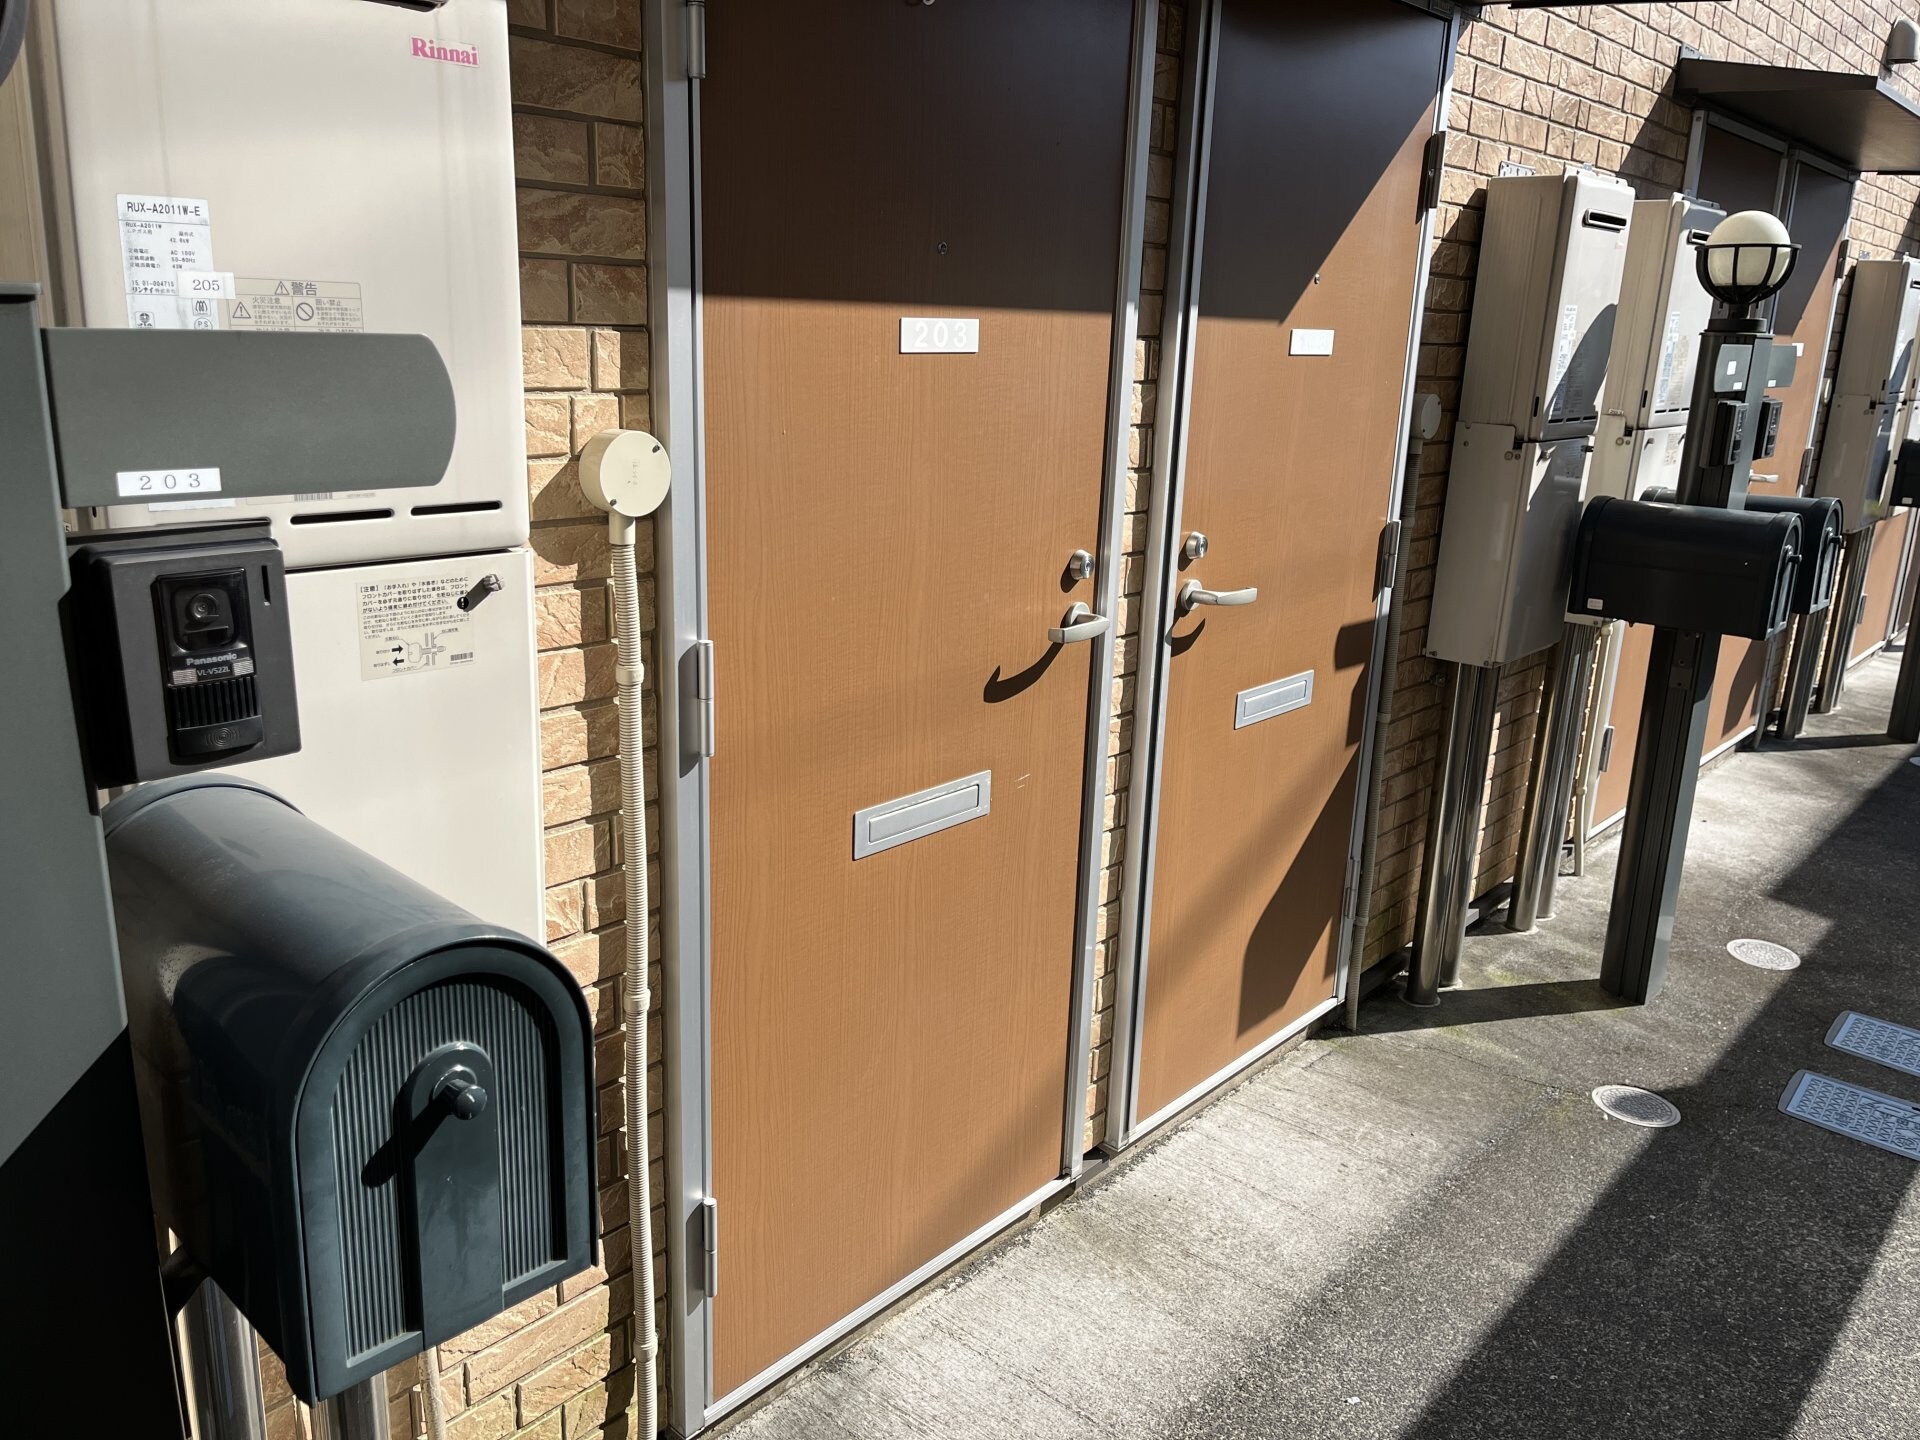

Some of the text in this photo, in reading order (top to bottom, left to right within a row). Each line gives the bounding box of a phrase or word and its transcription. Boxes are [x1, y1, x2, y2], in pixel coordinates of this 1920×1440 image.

[411, 37, 479, 65] Rinnai
[126, 201, 201, 217] RUX-A2011W-E
[192, 279, 220, 292] 205
[291, 281, 317, 296] 警告
[914, 321, 967, 348] 203
[186, 652, 237, 665] Panasonic
